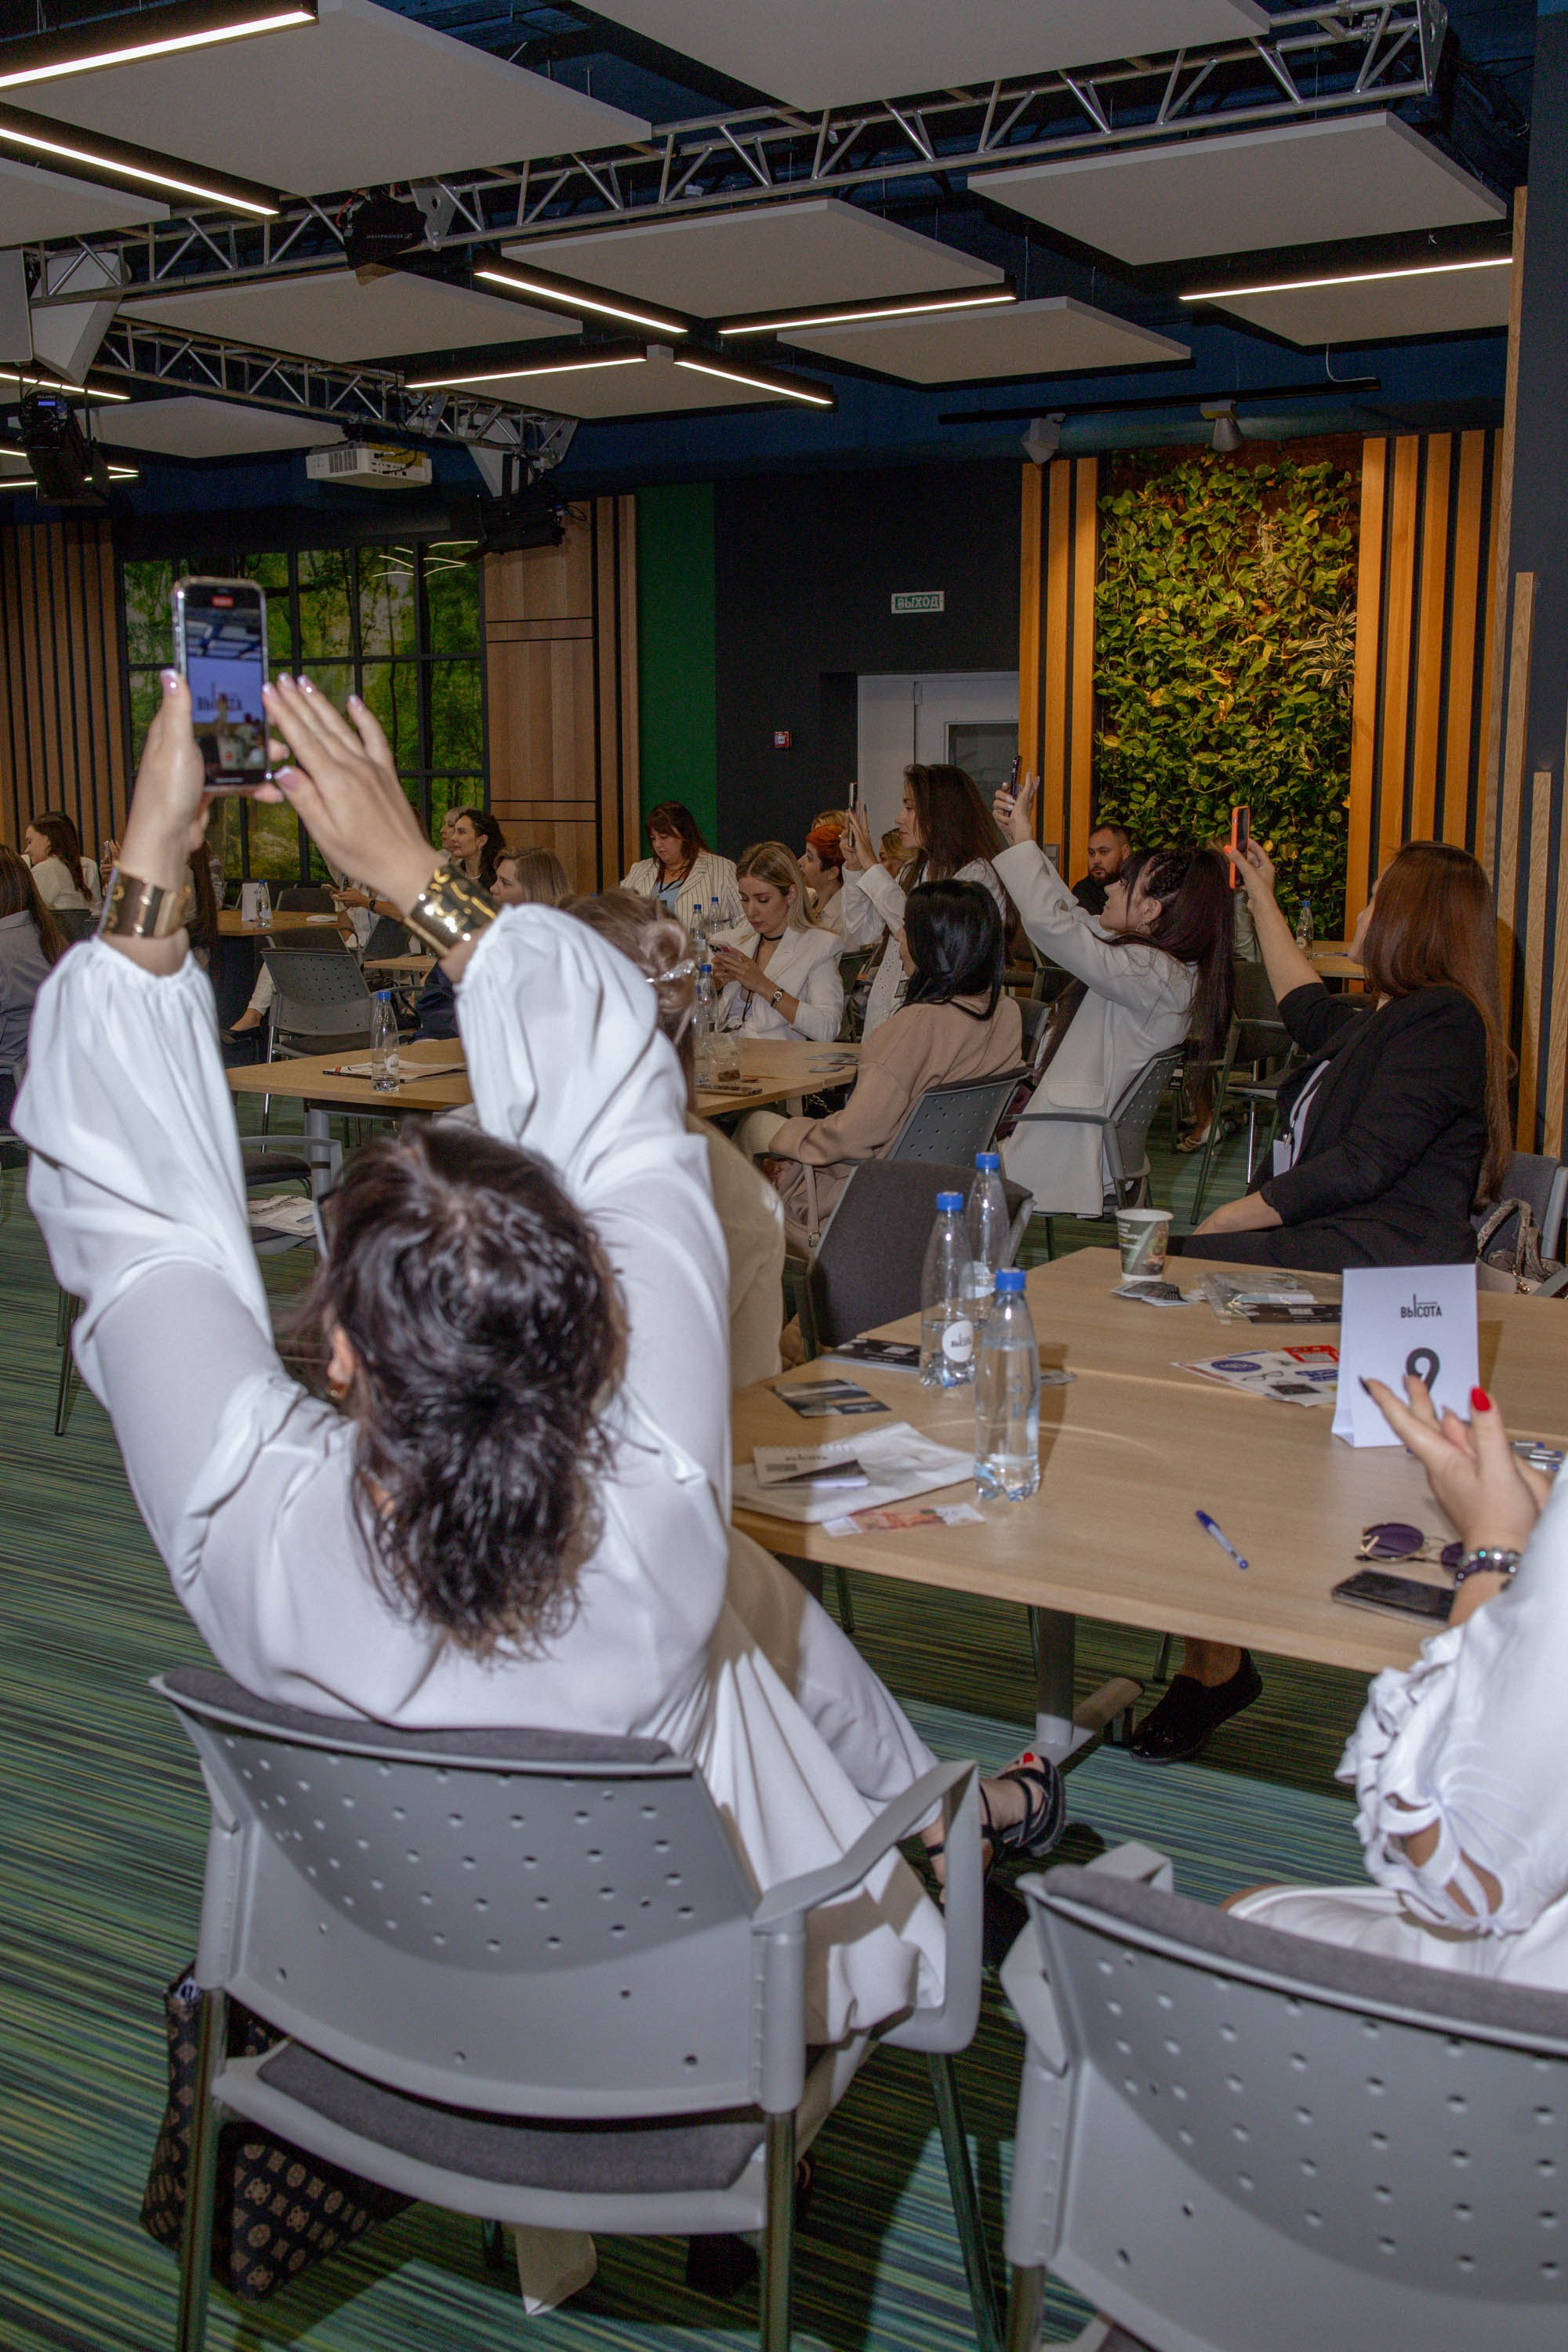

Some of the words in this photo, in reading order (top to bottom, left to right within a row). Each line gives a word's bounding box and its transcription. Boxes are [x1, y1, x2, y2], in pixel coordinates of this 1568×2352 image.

[897, 596, 939, 609] ВЫХОД
[1400, 1294, 1442, 1318] ВЫСОТА
[1406, 1347, 1439, 1393] 9
